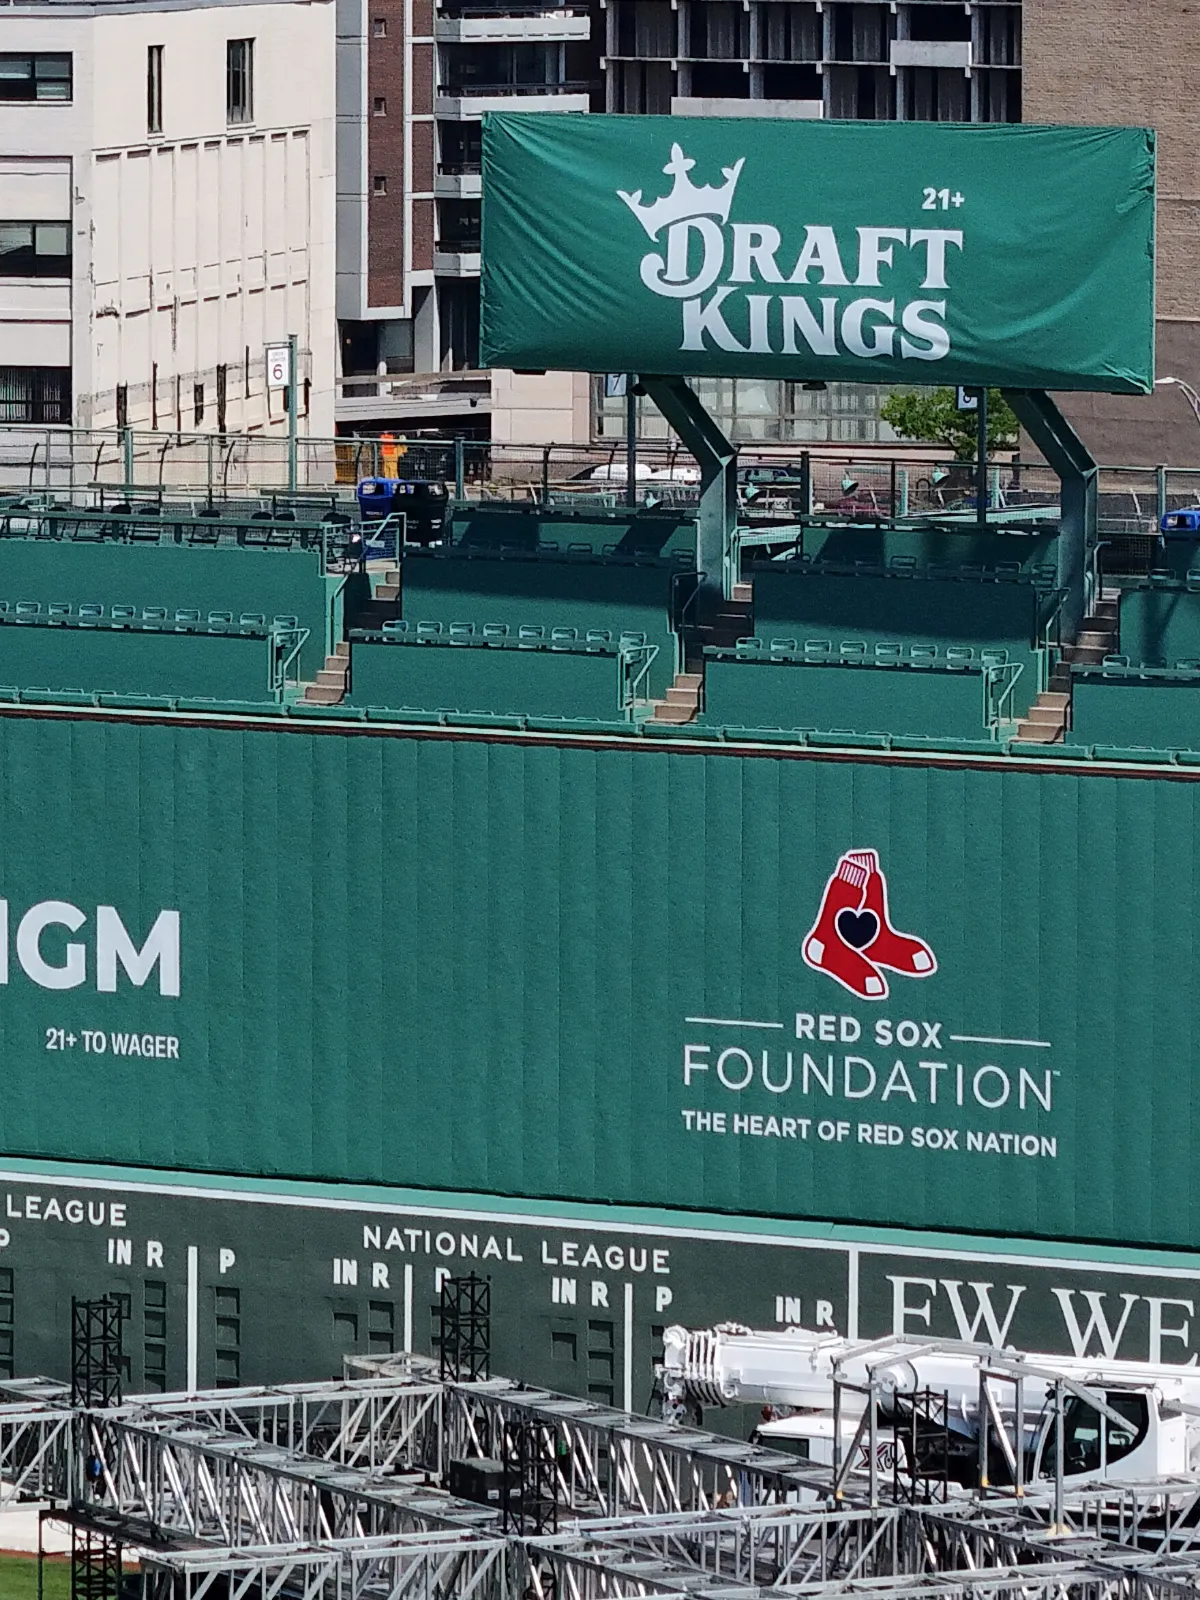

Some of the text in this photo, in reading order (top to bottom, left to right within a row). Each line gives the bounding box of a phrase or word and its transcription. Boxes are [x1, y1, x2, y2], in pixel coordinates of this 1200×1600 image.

[922, 187, 965, 210] 21+
[640, 216, 963, 298] DRAFT
[679, 286, 950, 361] KINGS
[273, 363, 283, 380] 6
[47, 1028, 179, 1059] 21+ TO WAGER
[796, 1013, 942, 1049] RED SOX
[682, 1111, 1056, 1158] THE HEART OF RED SOX NATION
[6, 1194, 127, 1227] LEAGUE
[108, 1238, 163, 1268] IN R
[220, 1249, 235, 1274] P
[364, 1225, 670, 1274] NATIONAL LEAGUE
[334, 1258, 389, 1289] IN R
[552, 1277, 608, 1307] IN R
[656, 1286, 672, 1312] P
[776, 1296, 834, 1326] IN R
